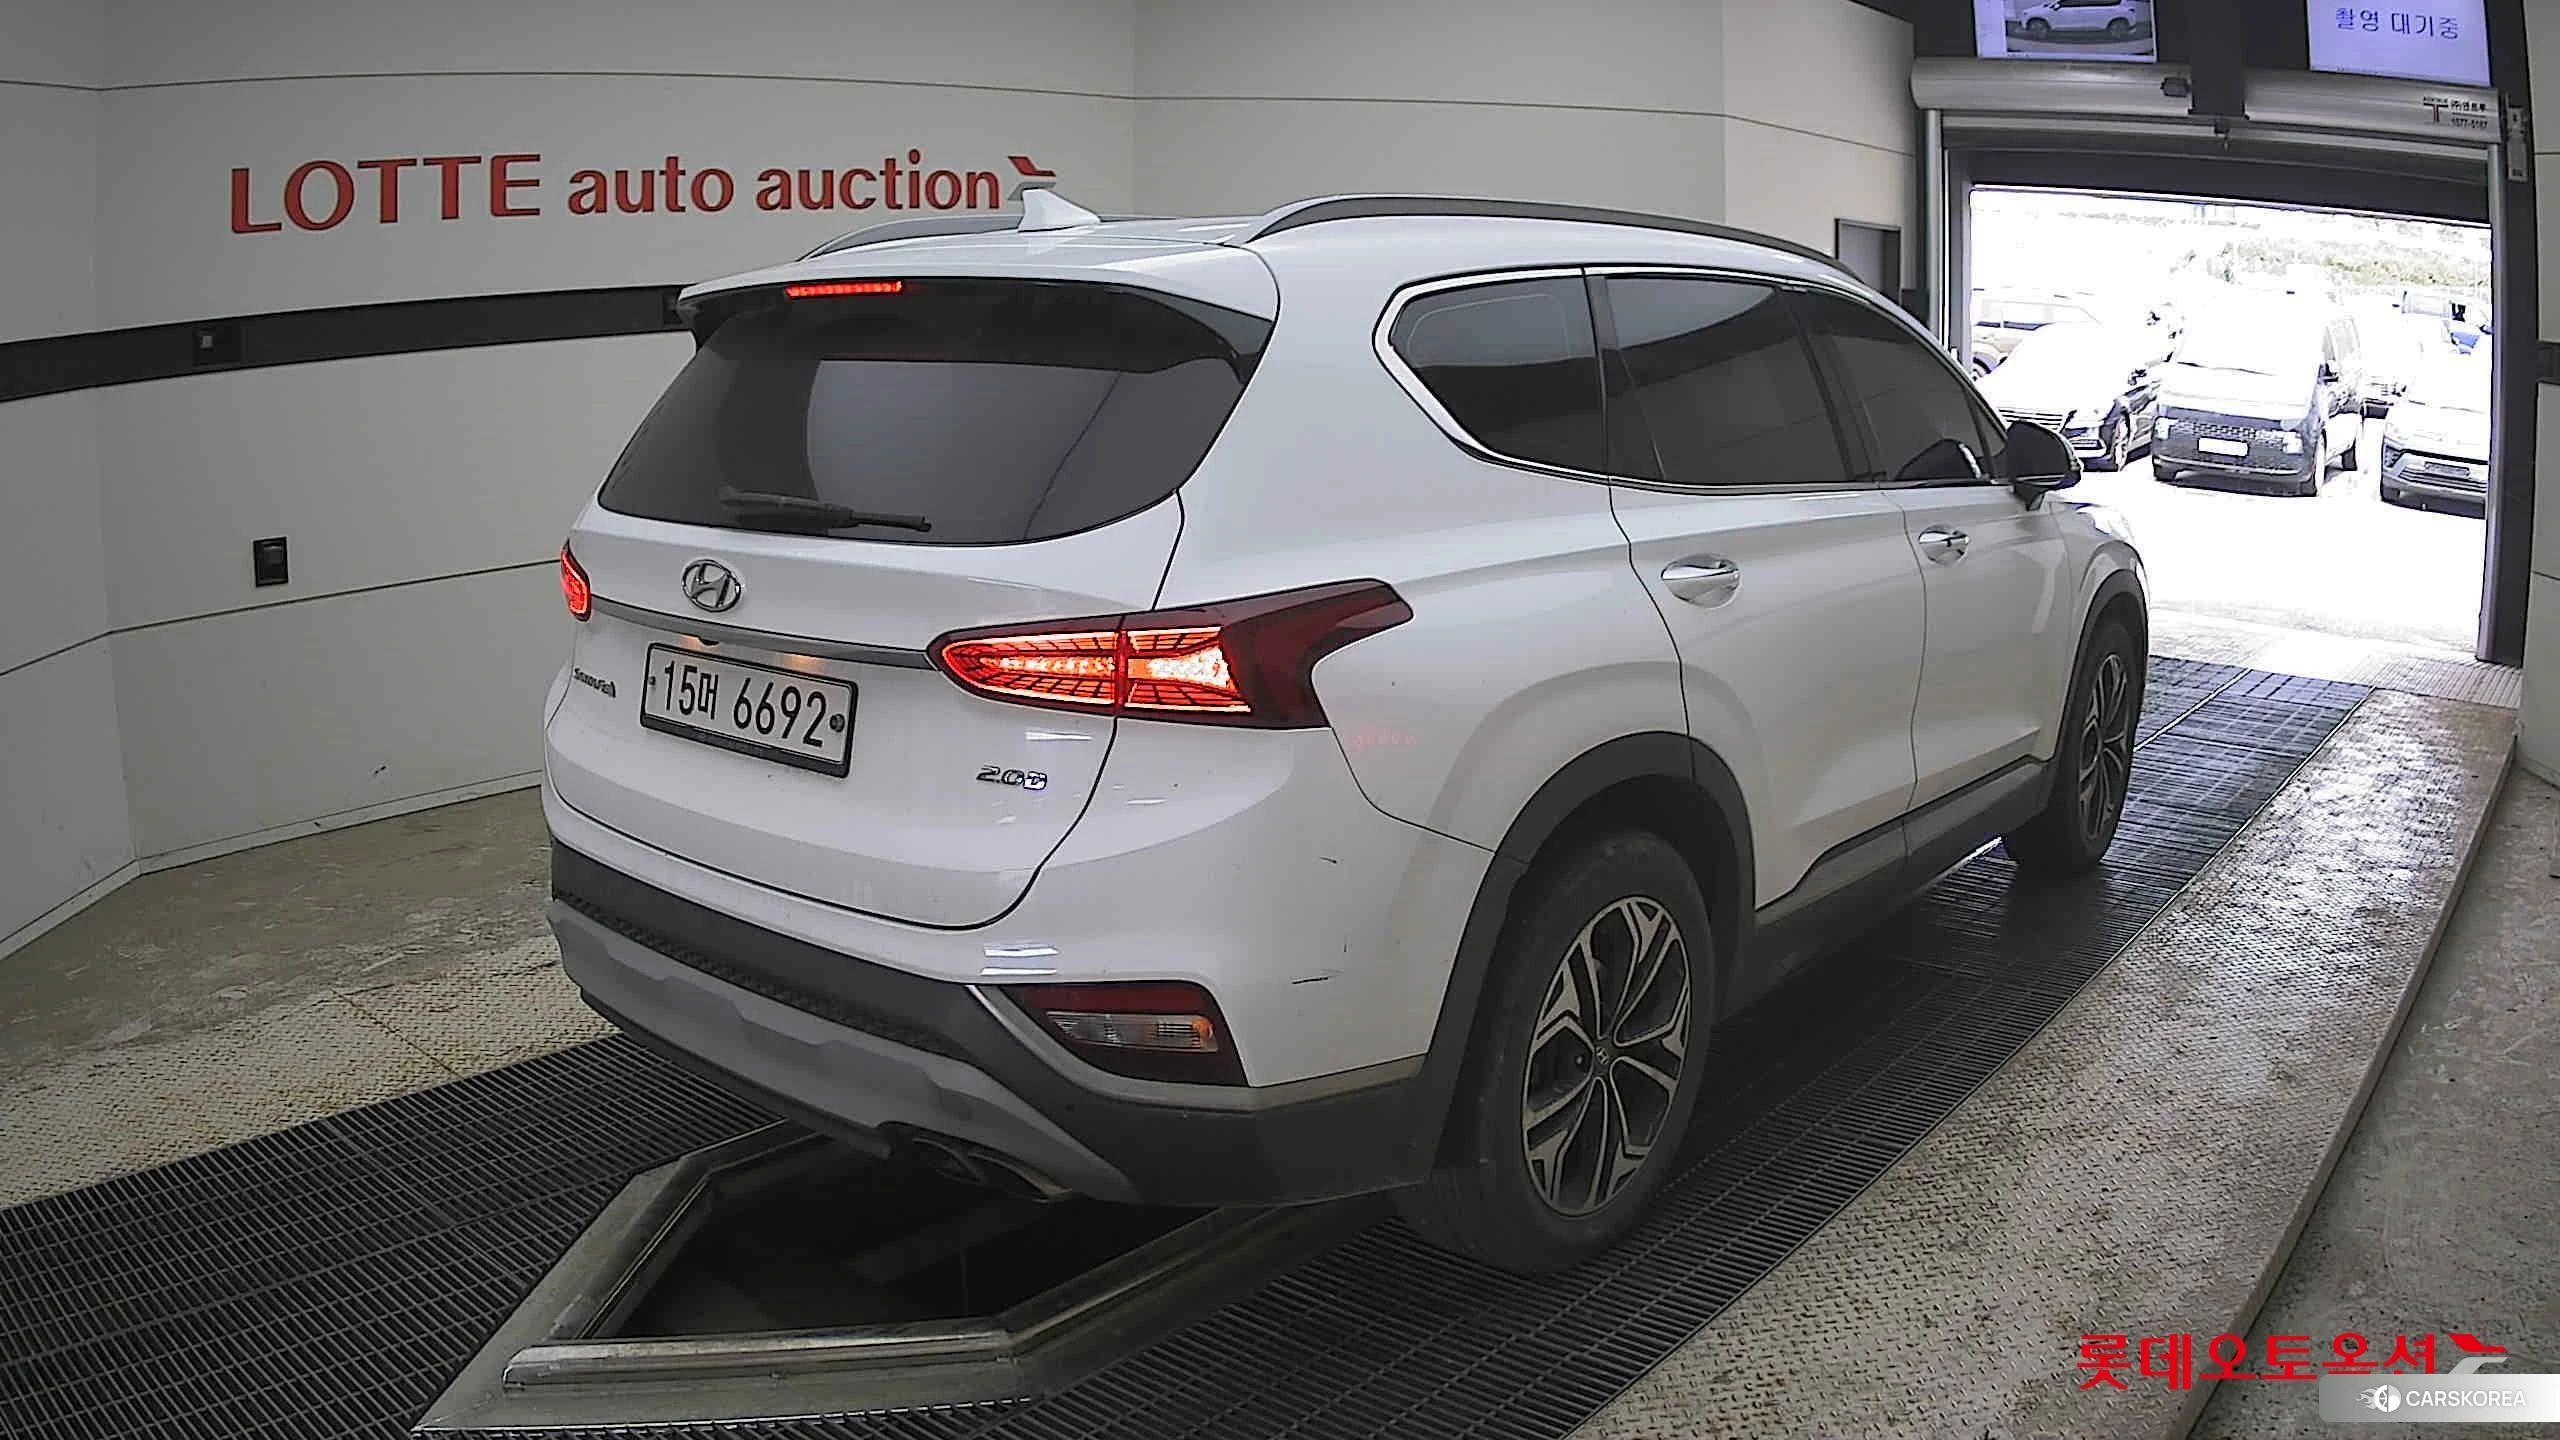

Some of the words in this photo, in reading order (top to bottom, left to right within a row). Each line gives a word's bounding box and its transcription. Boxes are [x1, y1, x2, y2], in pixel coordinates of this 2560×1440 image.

[2335, 7, 2380, 33] 촬영
[2390, 11, 2460, 40] 대기중
[231, 153, 541, 234] LOTTE
[567, 155, 735, 215] auto
[755, 148, 1001, 211] auction
[664, 659, 719, 721] 15머
[733, 676, 827, 749] 6692
